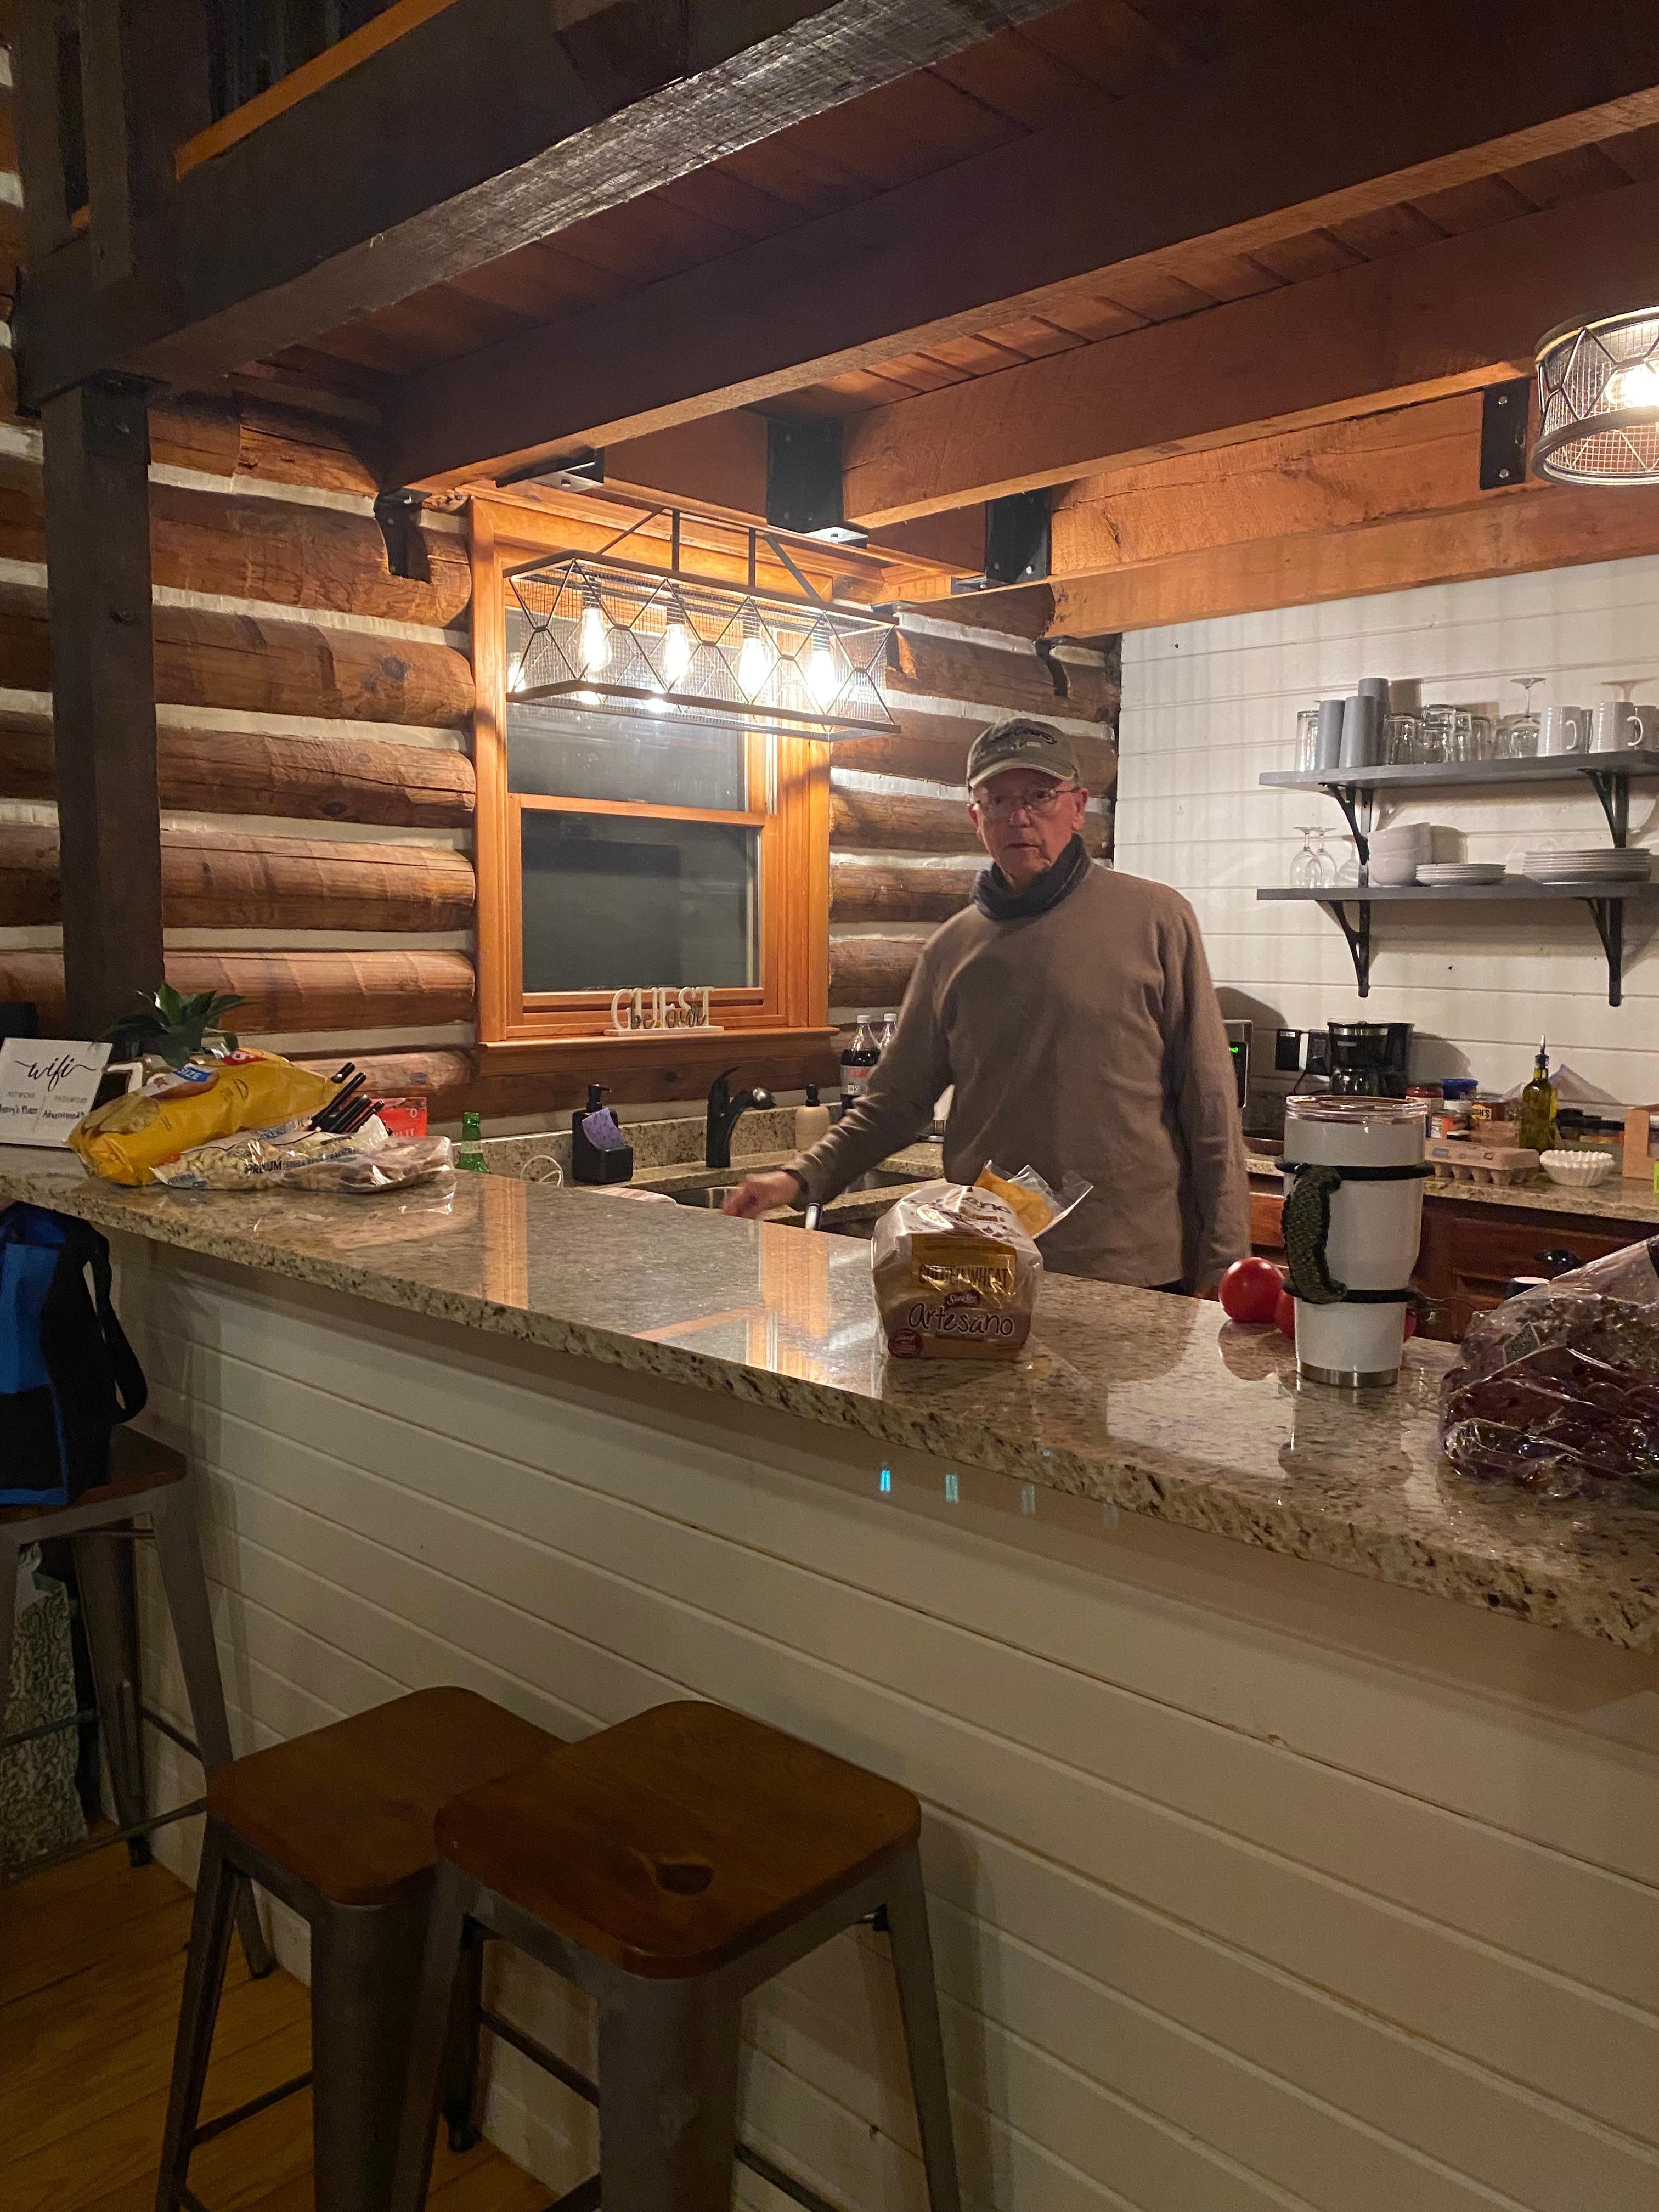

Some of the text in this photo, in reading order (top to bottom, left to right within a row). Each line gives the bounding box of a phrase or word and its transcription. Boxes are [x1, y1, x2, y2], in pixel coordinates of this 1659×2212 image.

[611, 986, 714, 1030] GUEST
[631, 996, 656, 1029] be
[15, 1054, 96, 1092] wifi
